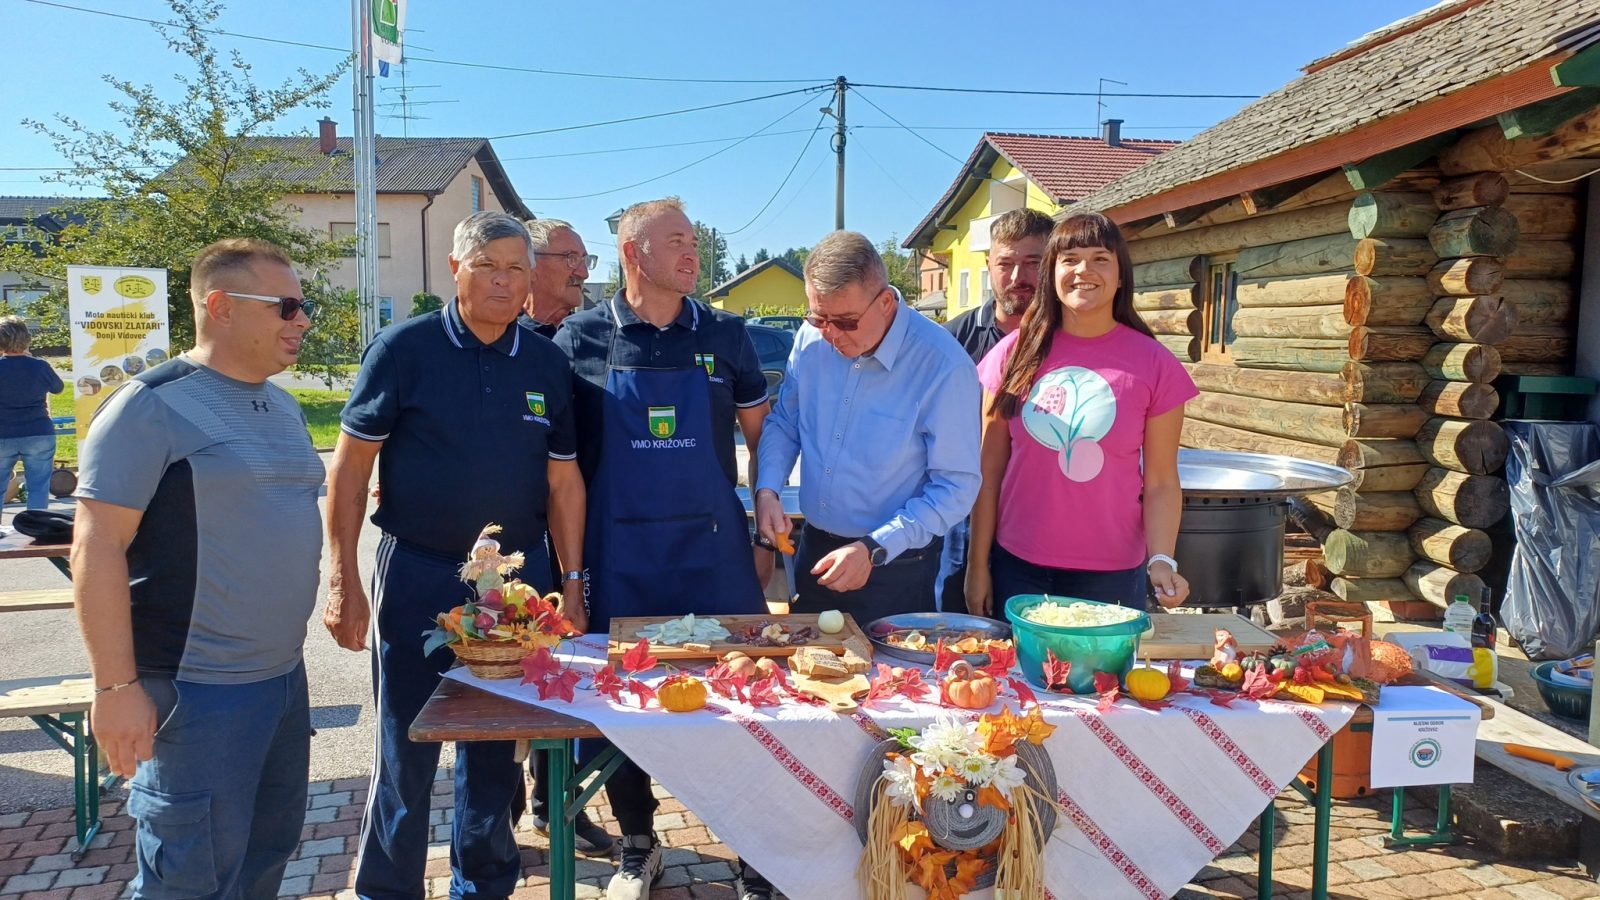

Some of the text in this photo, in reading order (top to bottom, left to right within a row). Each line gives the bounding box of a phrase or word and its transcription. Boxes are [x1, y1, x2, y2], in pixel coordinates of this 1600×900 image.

[139, 311, 155, 319] klub
[96, 331, 147, 340] Donji Vidovec
[630, 438, 697, 449] VMO KRIŽOVEC
